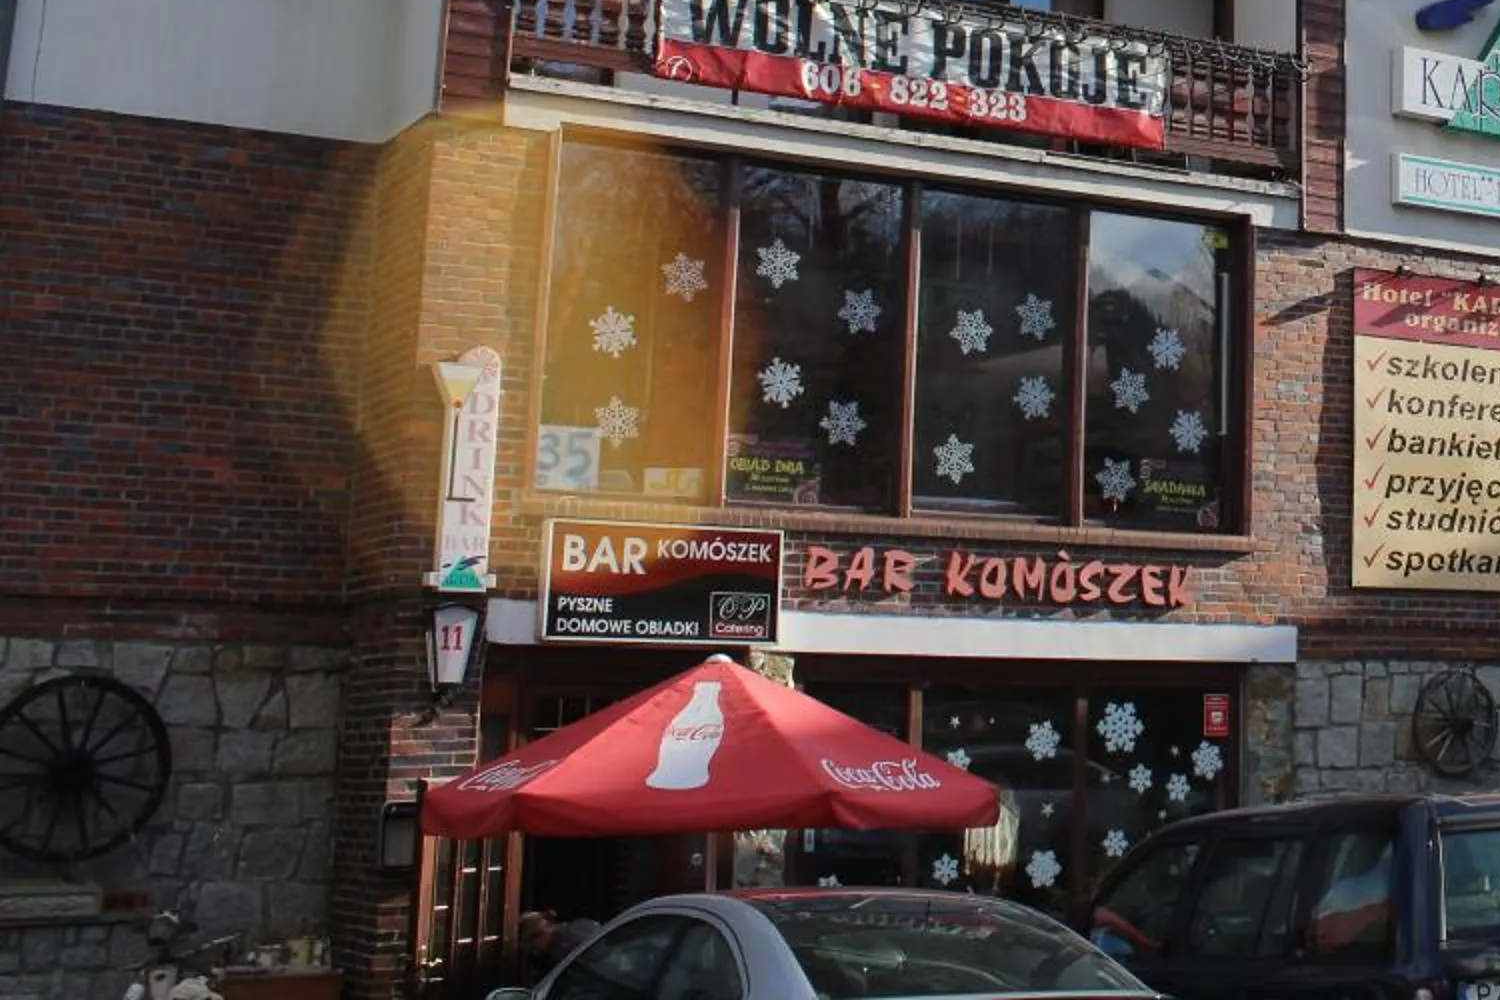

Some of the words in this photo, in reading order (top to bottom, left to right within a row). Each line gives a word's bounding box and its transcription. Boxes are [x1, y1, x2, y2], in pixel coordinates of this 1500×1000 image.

[930, 18, 1154, 106] POKOJE
[801, 59, 861, 98] 606
[889, 76, 949, 111] 822
[970, 86, 1027, 122] 323
[1415, 167, 1482, 201] HOTEL
[1362, 281, 1432, 308] Hotel
[460, 390, 496, 528] DRINK
[562, 533, 648, 576] BAR
[656, 537, 772, 564] KOMÓSZEK
[801, 545, 917, 593] BAR
[557, 596, 613, 613] PYSZNE
[439, 625, 464, 651] 11
[556, 617, 632, 634] DOMOWE
[635, 619, 700, 636] OBIADKI
[715, 621, 765, 638] Catering
[820, 756, 941, 791] Coca-Cola
